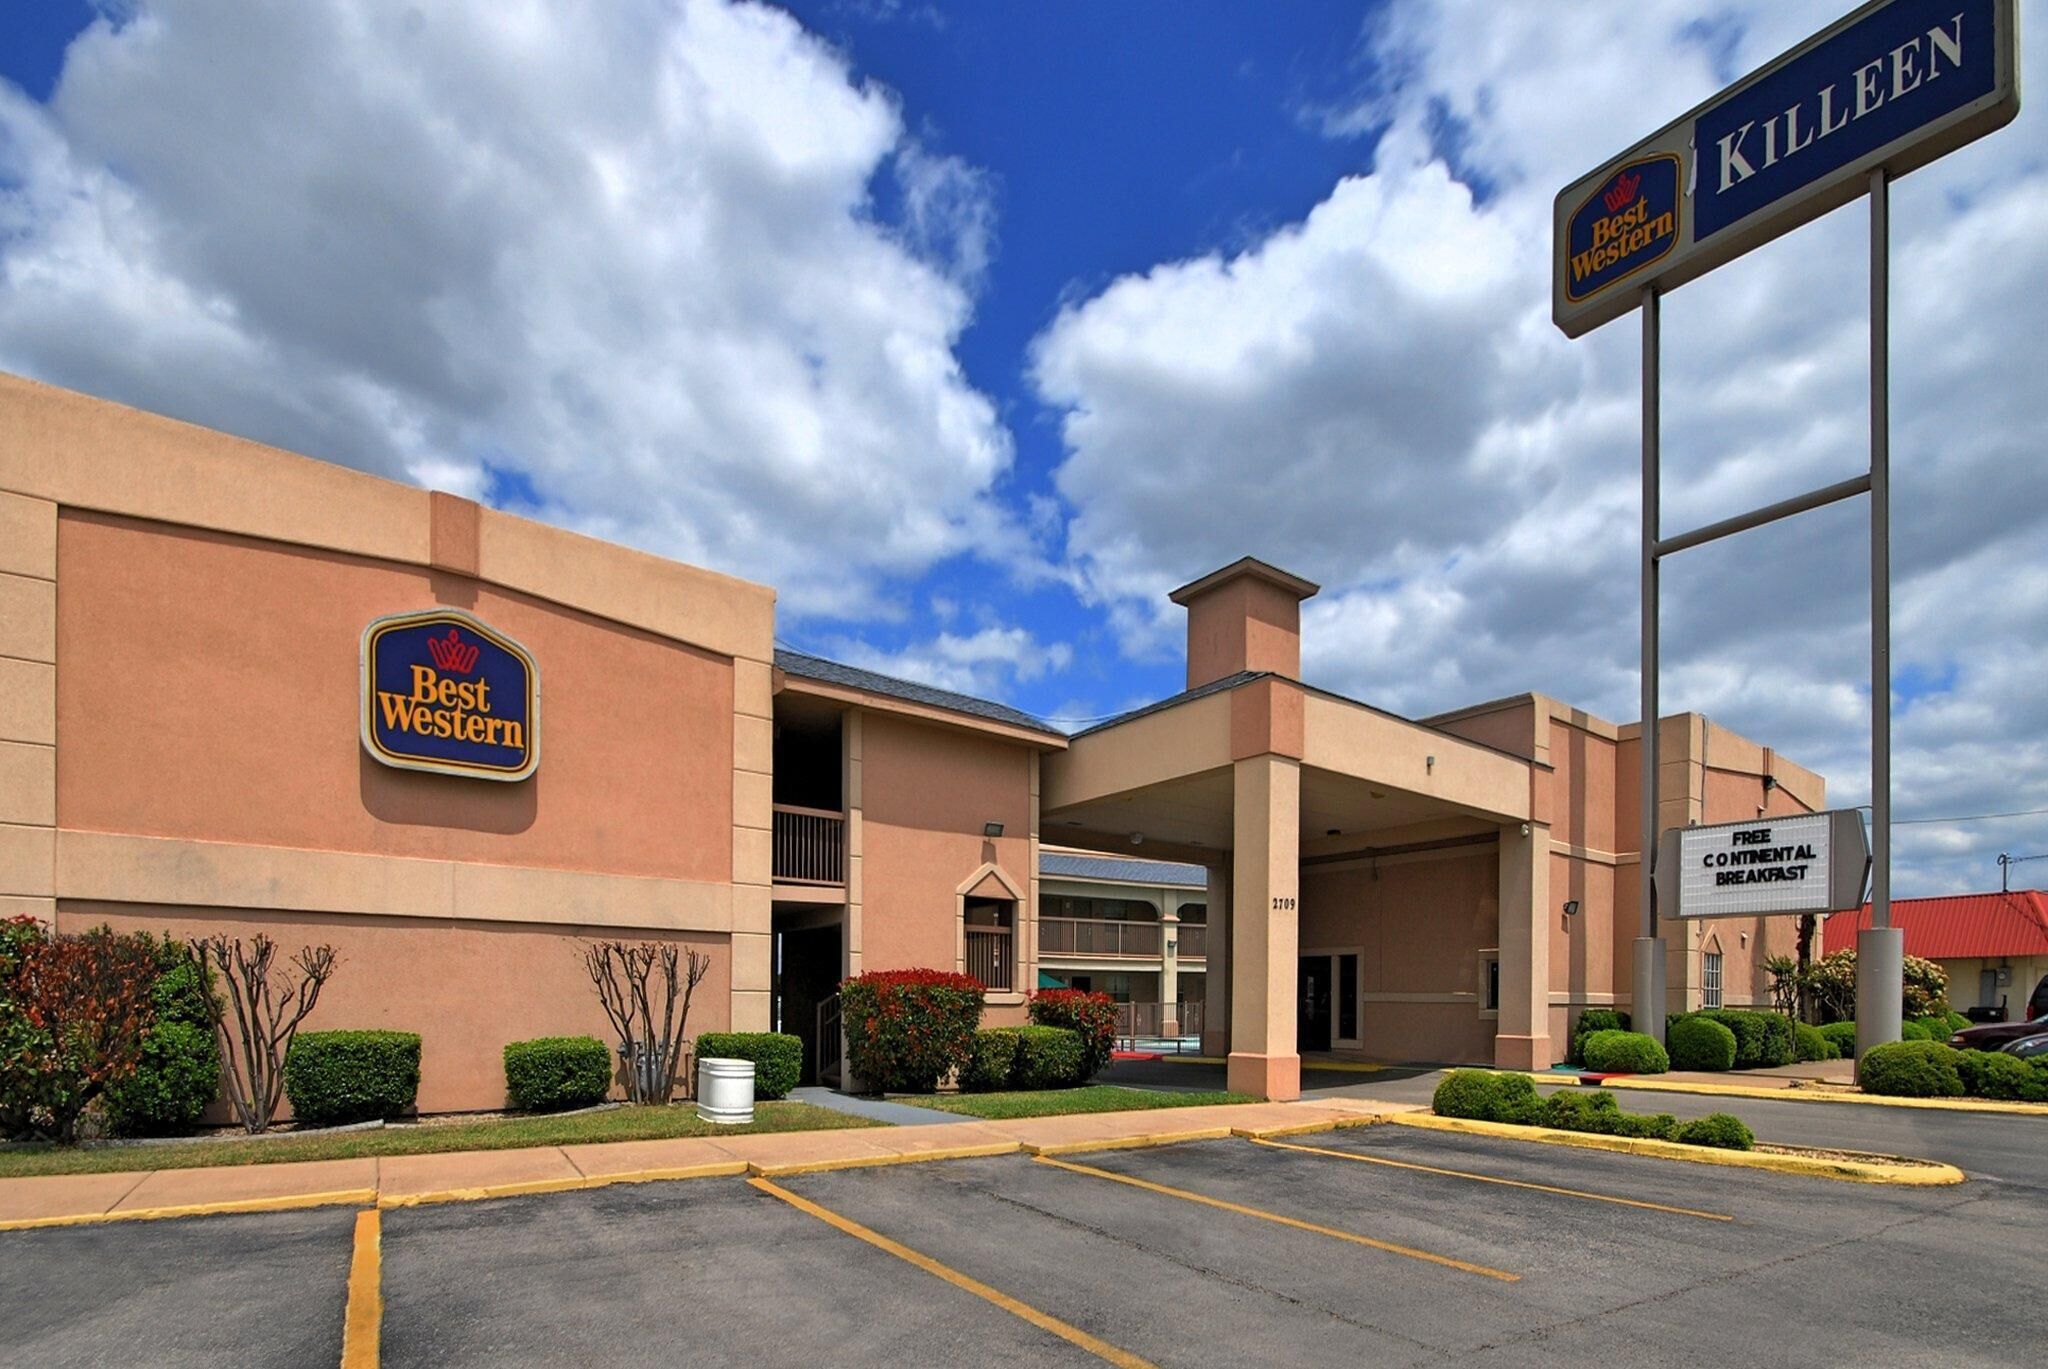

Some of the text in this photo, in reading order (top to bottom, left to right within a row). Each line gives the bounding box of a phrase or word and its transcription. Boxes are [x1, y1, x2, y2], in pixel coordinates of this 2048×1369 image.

[1716, 12, 1965, 195] KILLEEN
[1570, 211, 1673, 283] Western
[1591, 196, 1648, 249] Best
[410, 664, 490, 713] Best
[377, 691, 524, 749] Western
[1703, 844, 1817, 868] CONTINENTAL
[1732, 828, 1772, 846] FREE
[1715, 865, 1808, 886] BREAKFAST
[1272, 897, 1296, 910] 2709
